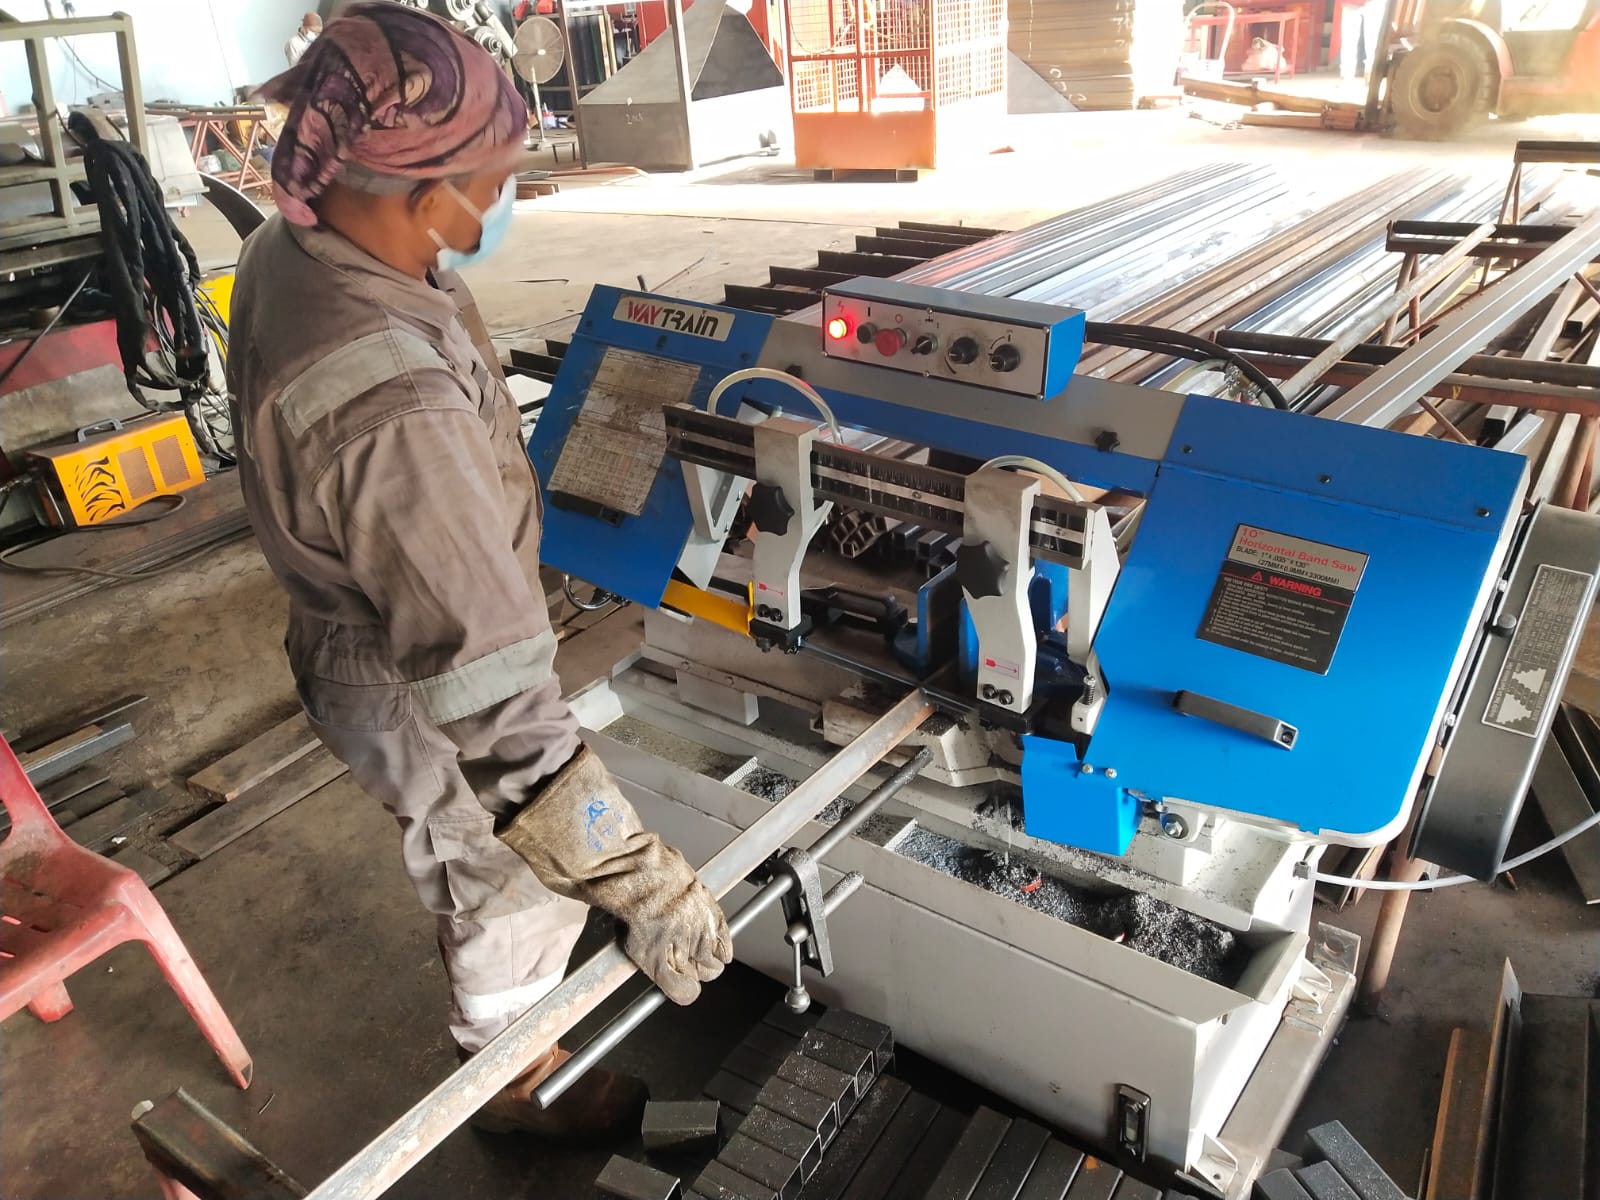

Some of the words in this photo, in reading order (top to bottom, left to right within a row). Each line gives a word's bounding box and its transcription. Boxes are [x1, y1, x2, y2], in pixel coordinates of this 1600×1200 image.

[627, 301, 719, 338] WAYTRAIN
[1236, 545, 1258, 557] BLADE:
[1239, 537, 1296, 558] Horizontal
[1299, 551, 1329, 566] Band
[1331, 560, 1358, 573] Saw
[1269, 575, 1322, 597] WARNING
